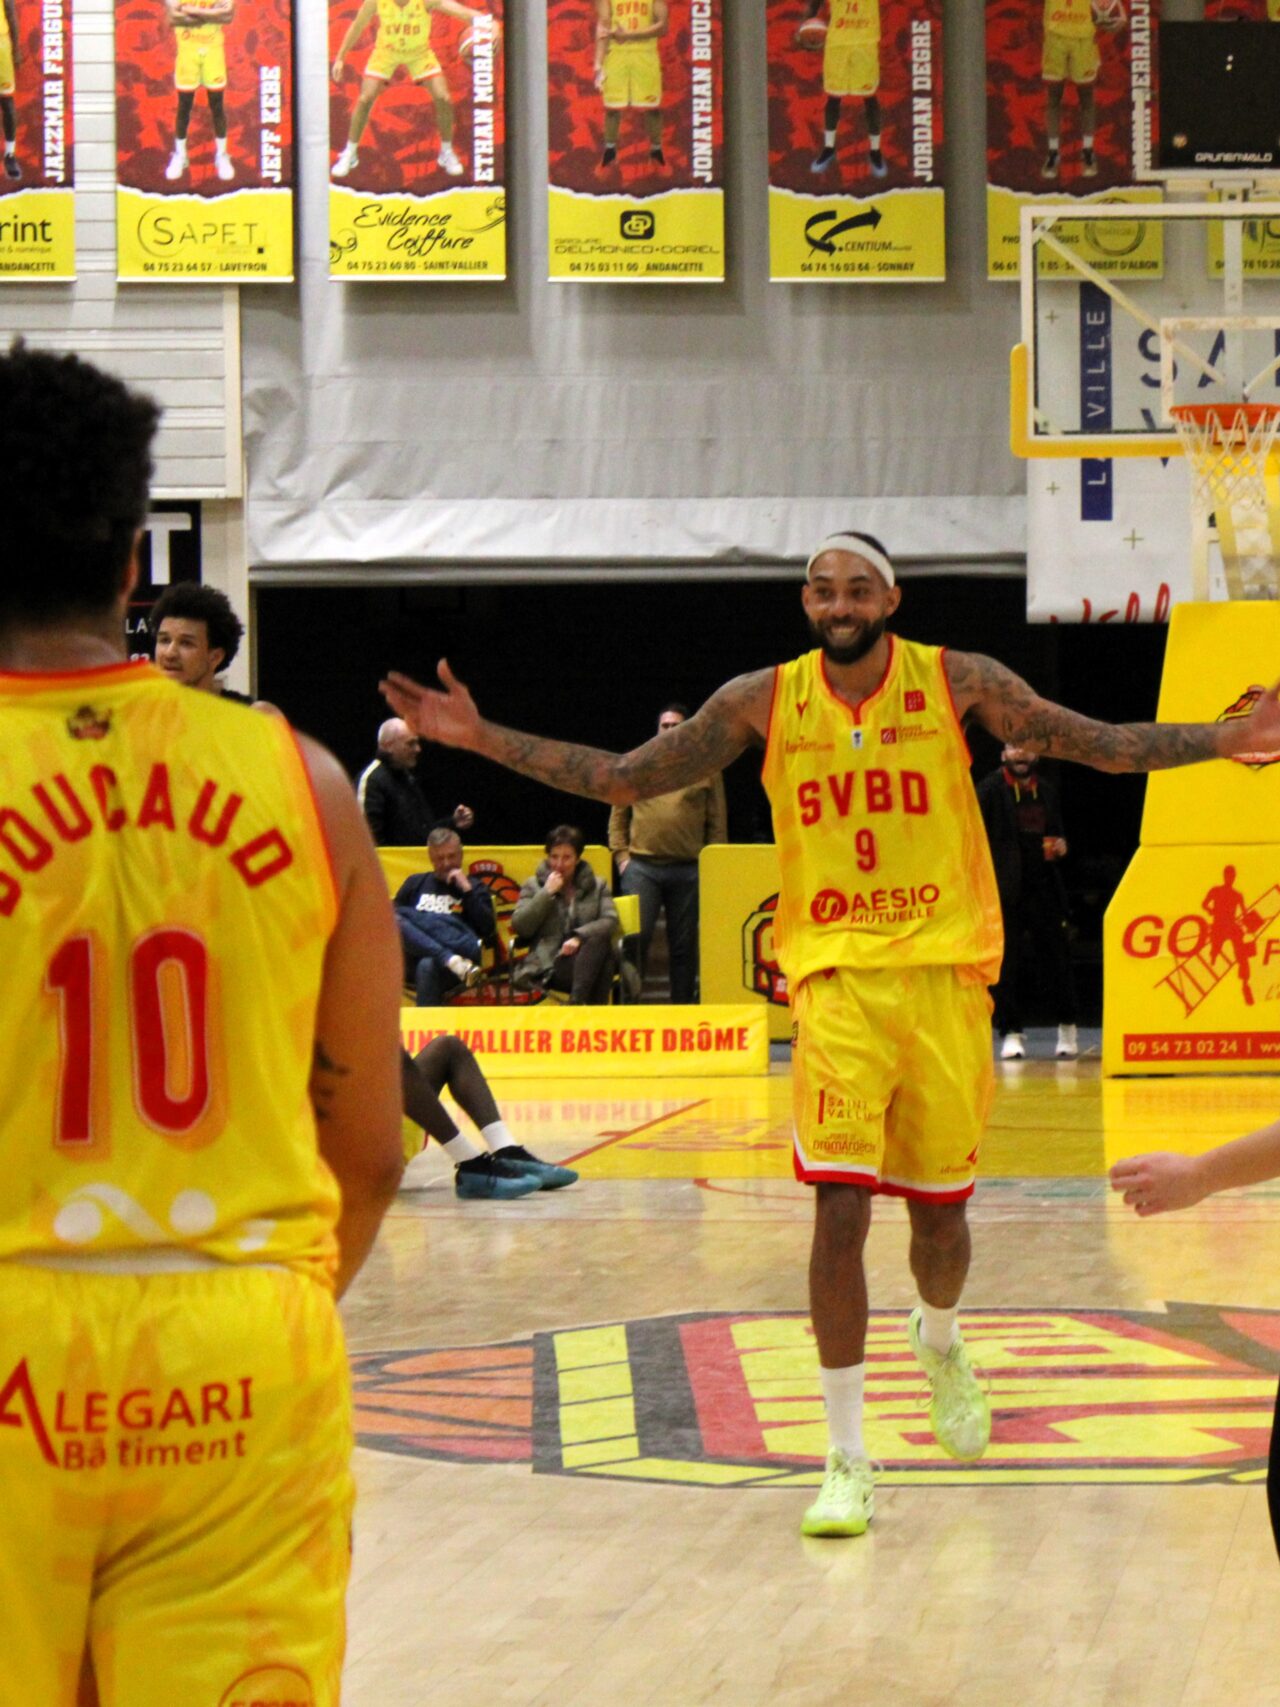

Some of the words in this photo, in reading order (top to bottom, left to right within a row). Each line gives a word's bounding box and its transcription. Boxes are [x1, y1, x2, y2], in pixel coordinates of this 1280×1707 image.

[43, 0, 65, 74] FERGU
[473, 15, 495, 103] MORATA
[692, 0, 713, 61] BOUC
[912, 21, 931, 90] DEGRE
[1131, 0, 1151, 101] ERRADJ
[260, 66, 282, 123] KEBE
[43, 80, 65, 182] JAZZMAR
[473, 110, 494, 181] ETHAN
[692, 68, 713, 182] JONATHAN
[912, 97, 932, 181] JORDAN
[260, 130, 282, 183] JEFF
[353, 203, 452, 228] Evidence
[386, 227, 475, 257] Coiffure
[1086, 309, 1106, 418] VILLE
[796, 768, 931, 827] SVBD
[855, 828, 877, 873] 9
[850, 884, 940, 914] AÉSIO
[850, 906, 935, 924] MUTUELLE
[1122, 914, 1210, 959] GO
[47, 927, 210, 1146] 10
[457, 1030, 552, 1053] VALLIER
[561, 1029, 654, 1053] BASKET
[662, 1021, 749, 1052] DRÔME
[1127, 1041, 1146, 1055] 09
[1151, 1041, 1169, 1055] 54
[1175, 1040, 1191, 1054] 73
[1196, 1040, 1215, 1054] 02
[1219, 1039, 1238, 1053] 24
